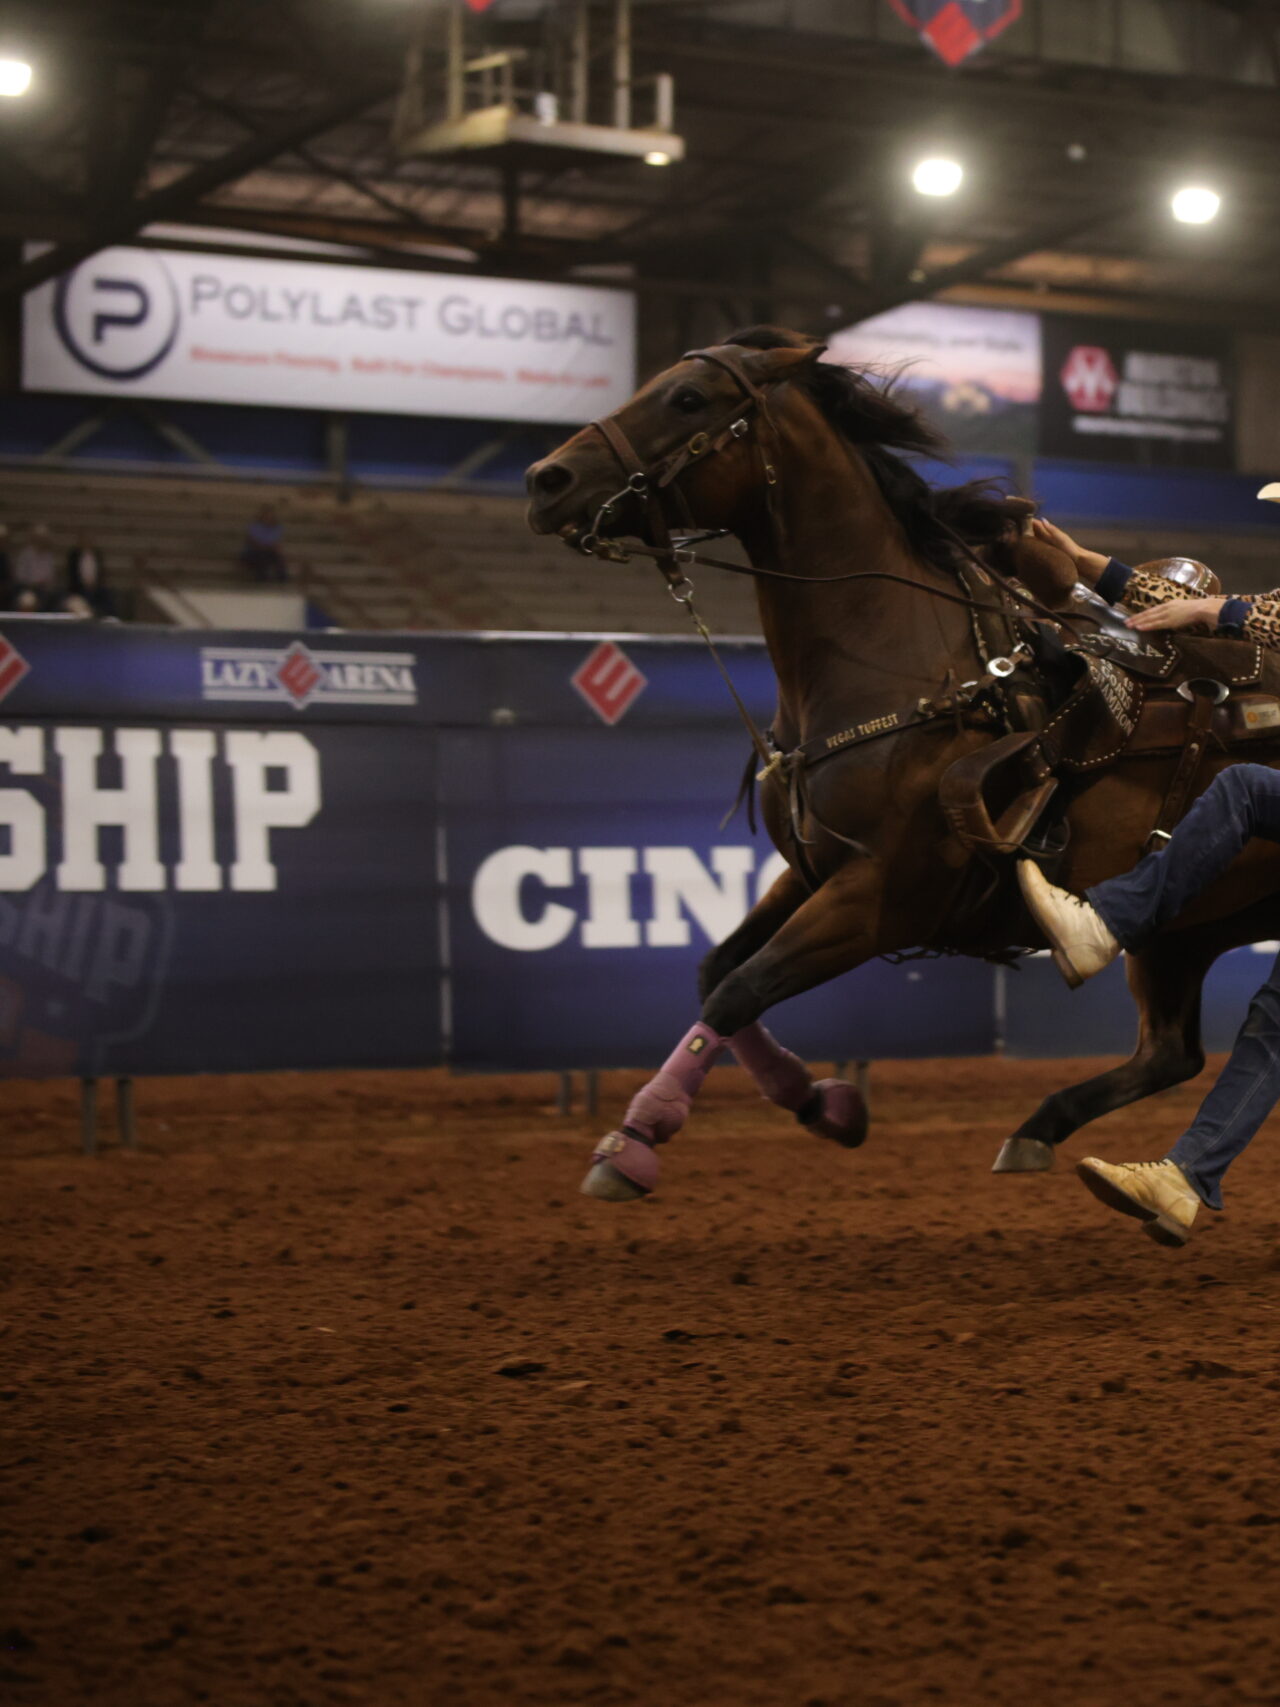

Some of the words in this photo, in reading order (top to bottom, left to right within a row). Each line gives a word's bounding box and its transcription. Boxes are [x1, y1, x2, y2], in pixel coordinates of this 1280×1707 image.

[190, 275, 420, 330] POLYLAST
[436, 295, 614, 347] GLOBAL
[201, 659, 274, 688] LAZY
[324, 664, 417, 692] ARENA
[825, 727, 856, 749] VEGAS
[857, 712, 899, 736] TUFFEST
[472, 845, 790, 952] CIN
